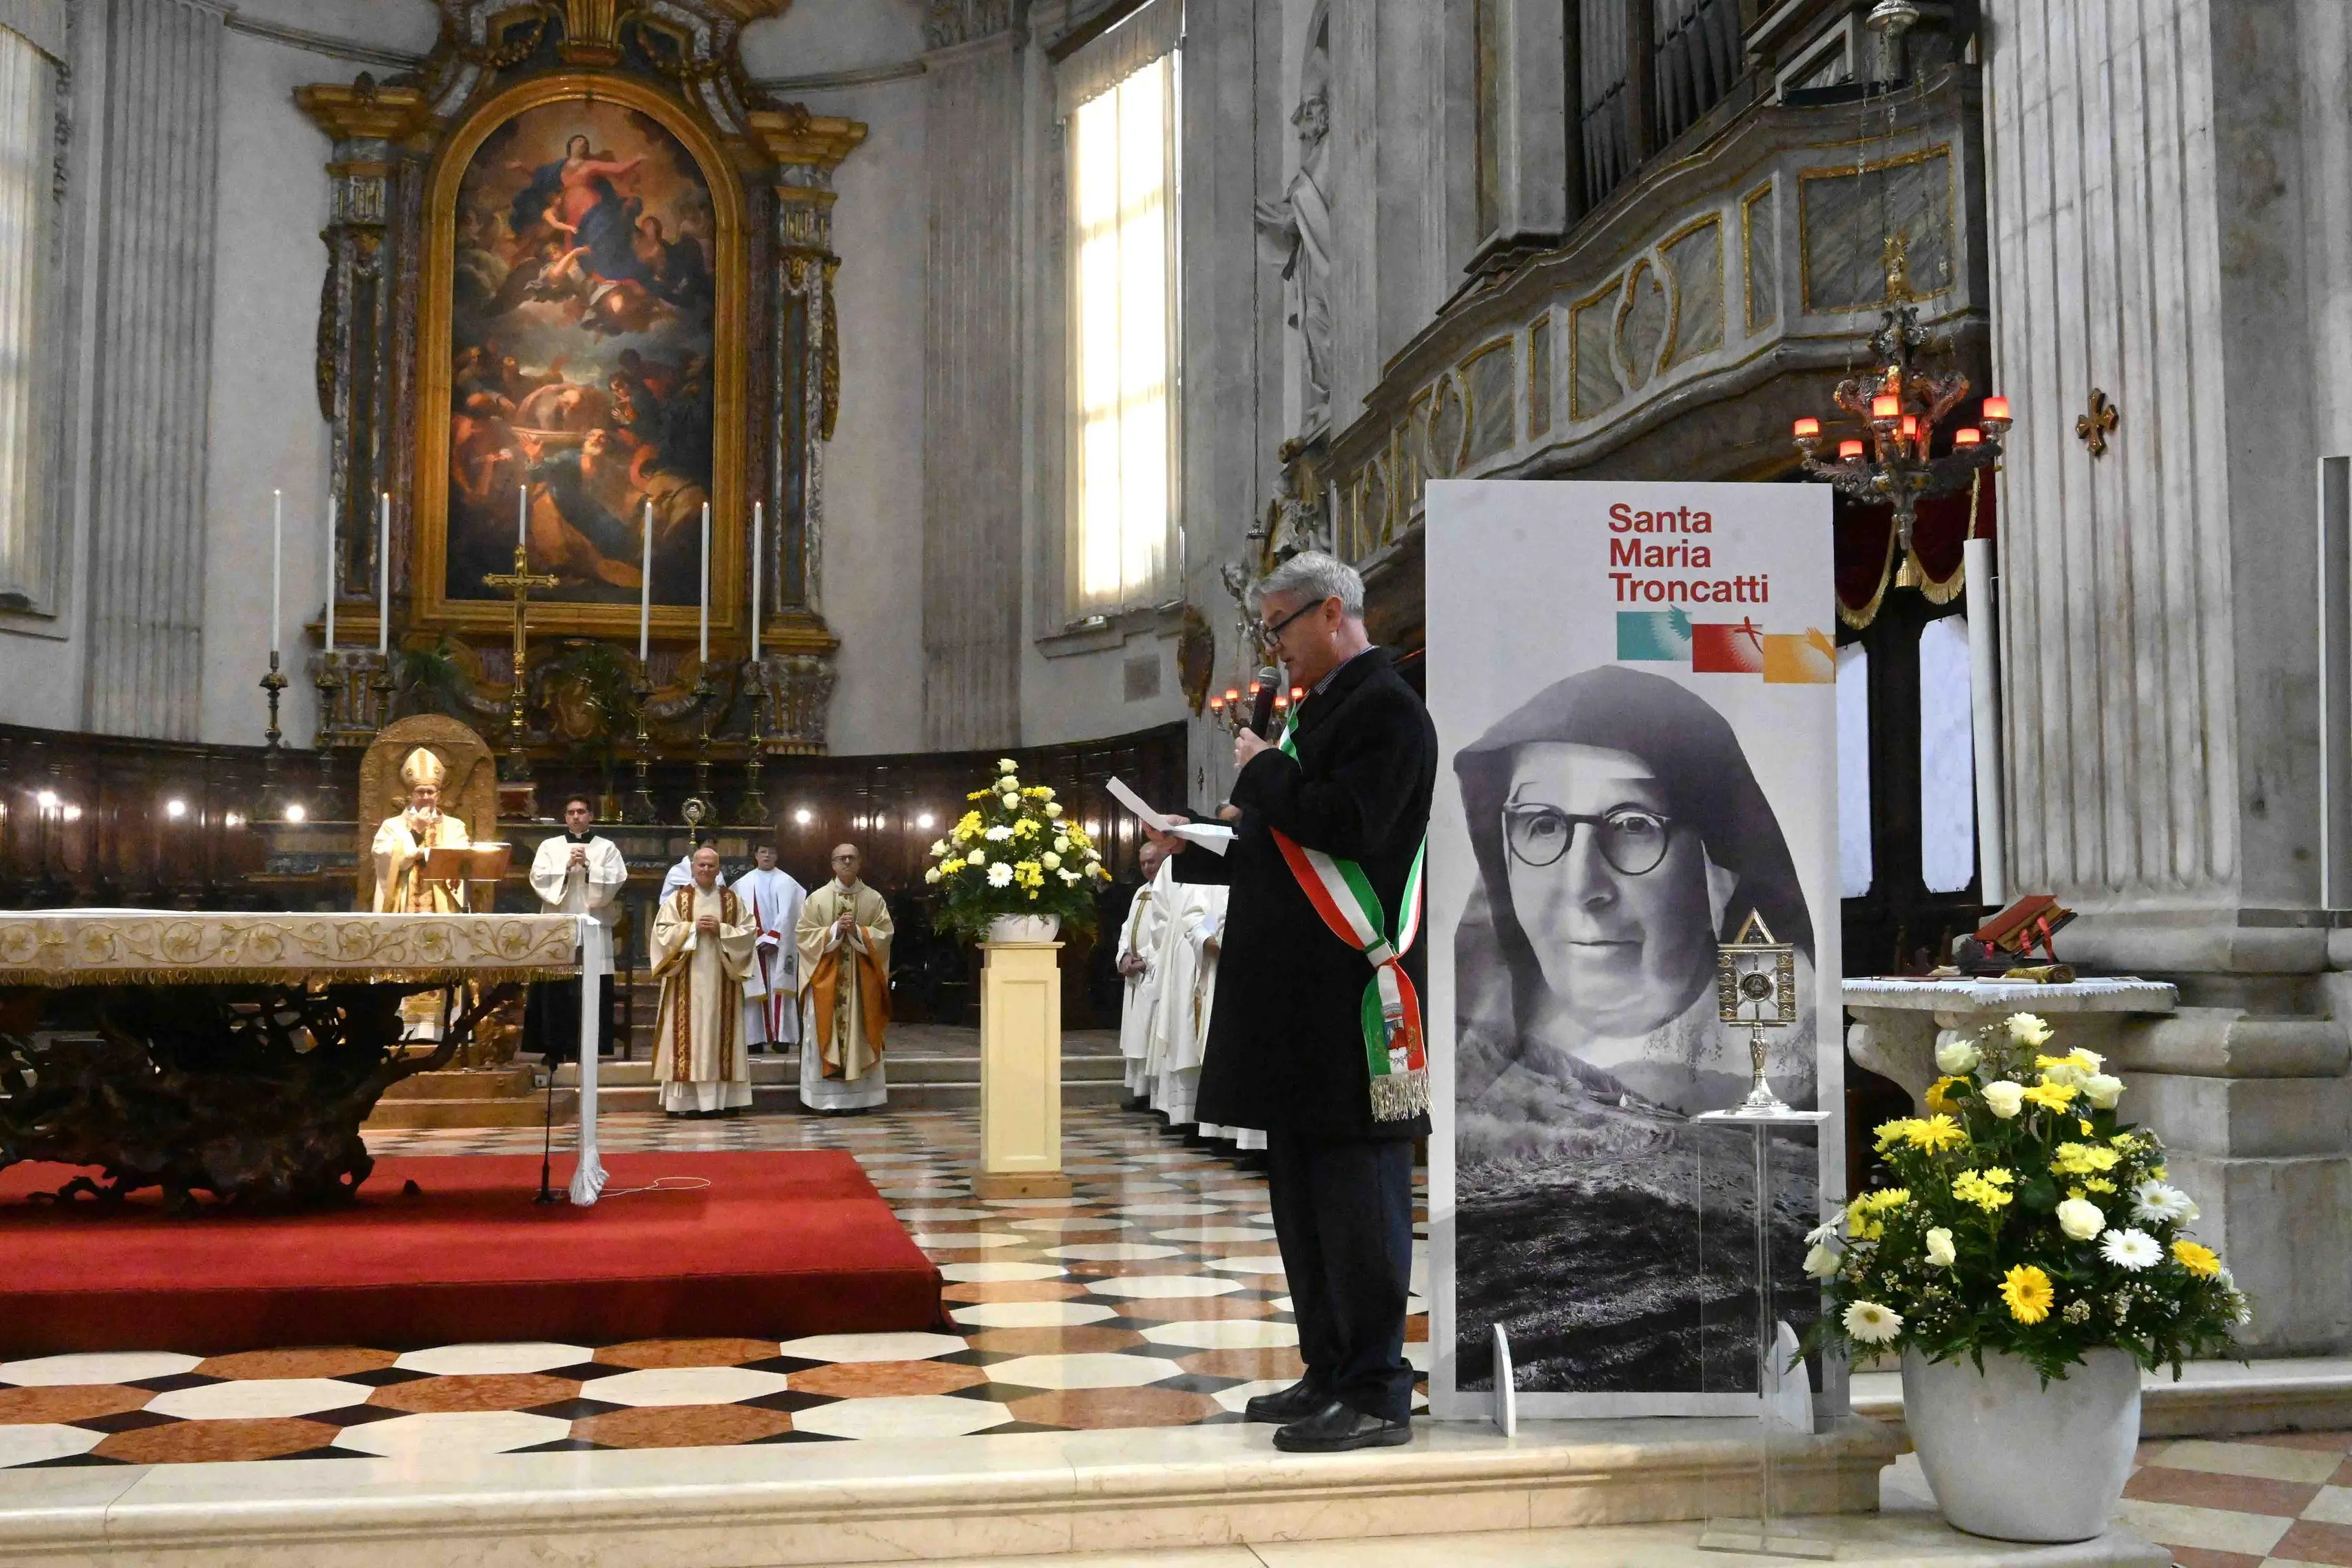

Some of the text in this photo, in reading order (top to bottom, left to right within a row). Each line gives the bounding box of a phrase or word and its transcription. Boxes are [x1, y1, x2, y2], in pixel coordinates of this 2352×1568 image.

[1609, 503, 1712, 533] Santa
[1609, 537, 1711, 568] Maria
[1609, 572, 1768, 603] Troncatti
